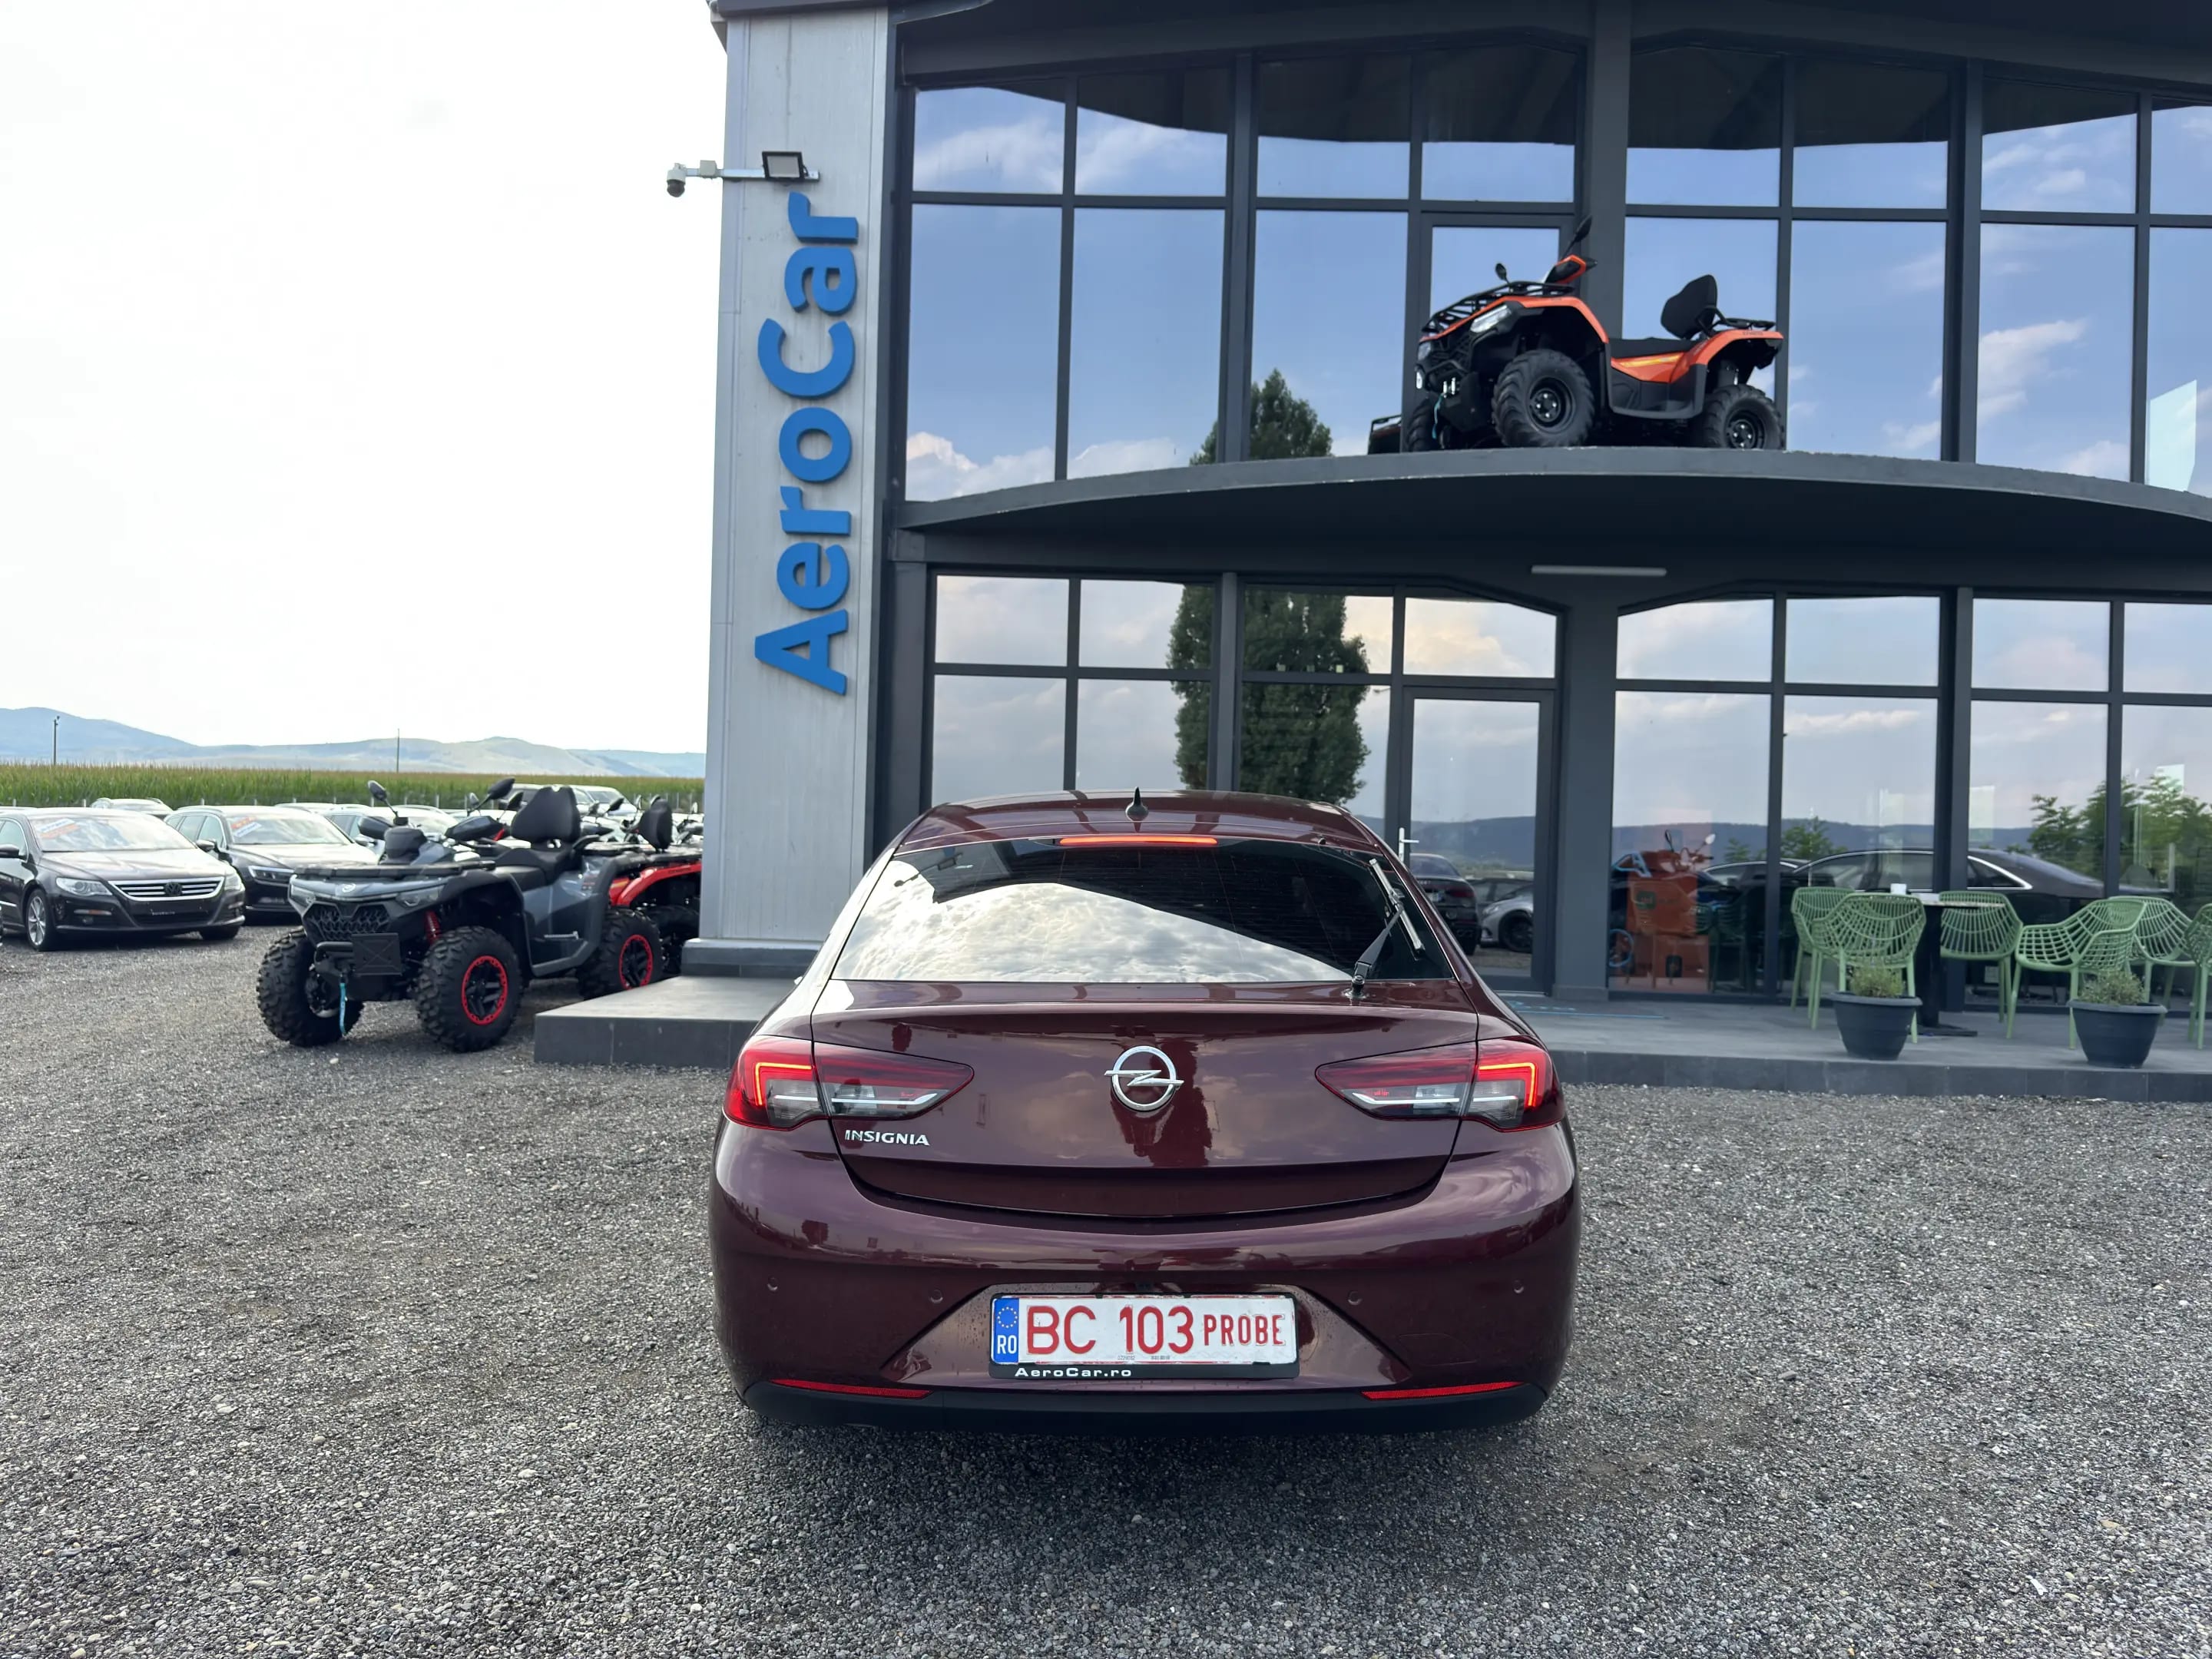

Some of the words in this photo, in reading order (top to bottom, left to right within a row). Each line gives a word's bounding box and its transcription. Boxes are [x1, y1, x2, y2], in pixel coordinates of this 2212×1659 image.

[754, 190, 859, 696] AeroCar
[845, 1130, 930, 1146] INSIGNIA
[1027, 1305, 1097, 1354] BC
[1119, 1305, 1194, 1354] 103
[1204, 1314, 1285, 1346] PROBE
[997, 1335, 1017, 1354] RO
[1015, 1367, 1132, 1377] AeroCar.ro
